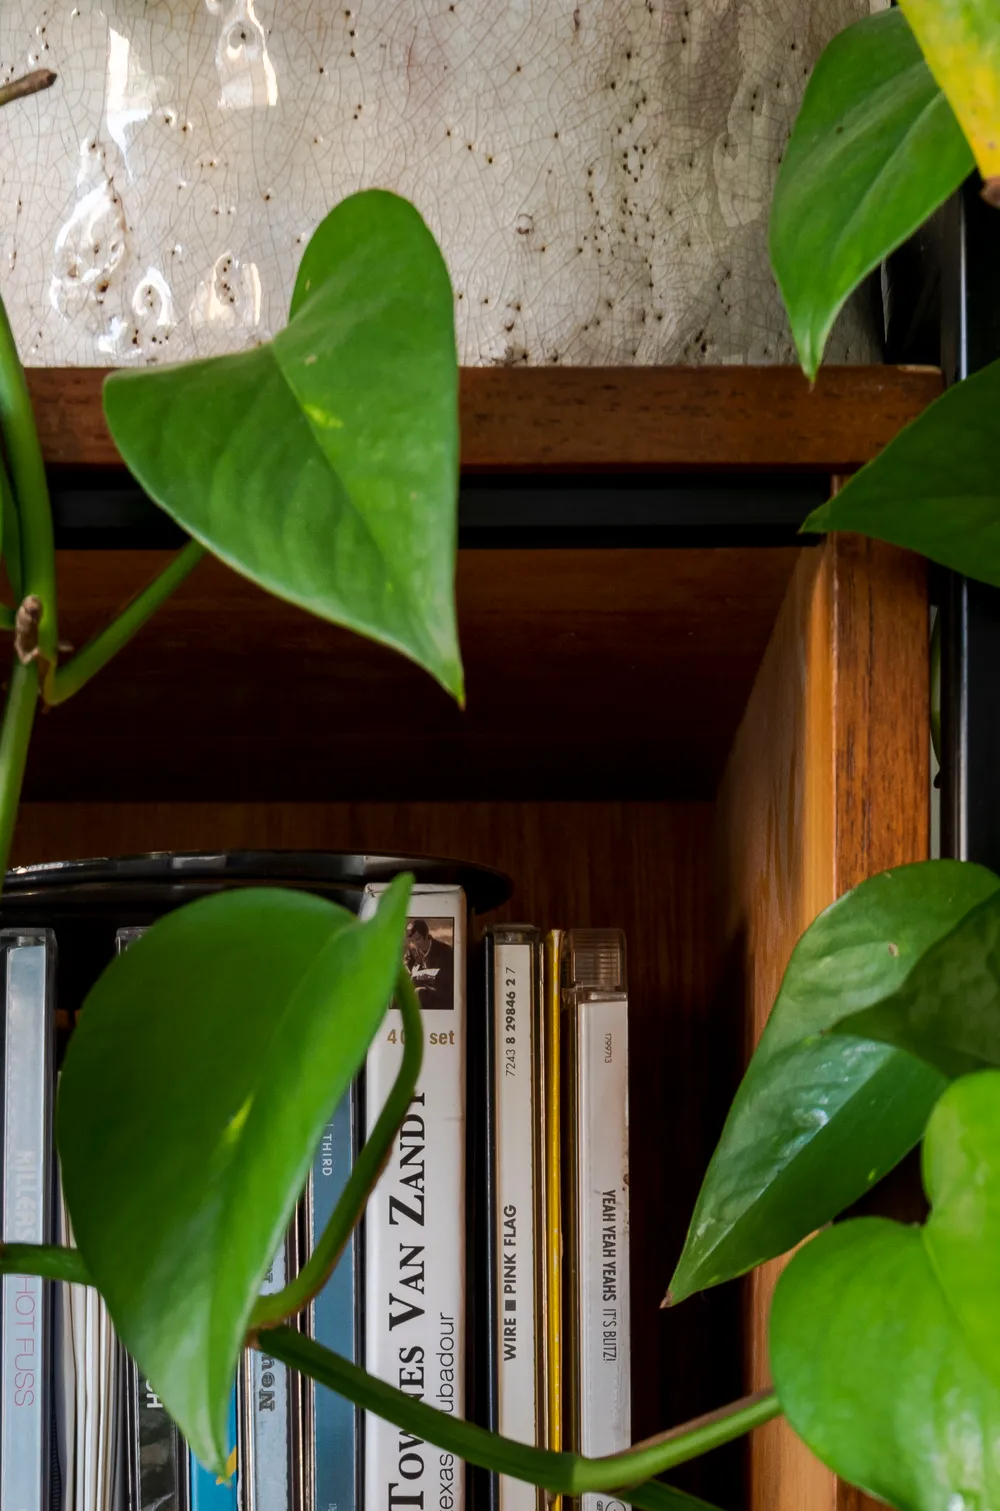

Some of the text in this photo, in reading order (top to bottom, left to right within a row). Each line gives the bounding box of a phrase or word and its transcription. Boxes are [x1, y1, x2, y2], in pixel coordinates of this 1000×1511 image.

[430, 1029, 455, 1045] set
[505, 991, 516, 1076] 7243 29846
[322, 1133, 333, 1176] THIRD
[388, 1243, 425, 1331] VAN
[504, 1204, 517, 1361] WIRE PINK FLAG
[602, 1190, 617, 1362] YEAH YEAH YEAHS IT'S BLITZ!
[14, 1275, 35, 1407] HOT FUSS
